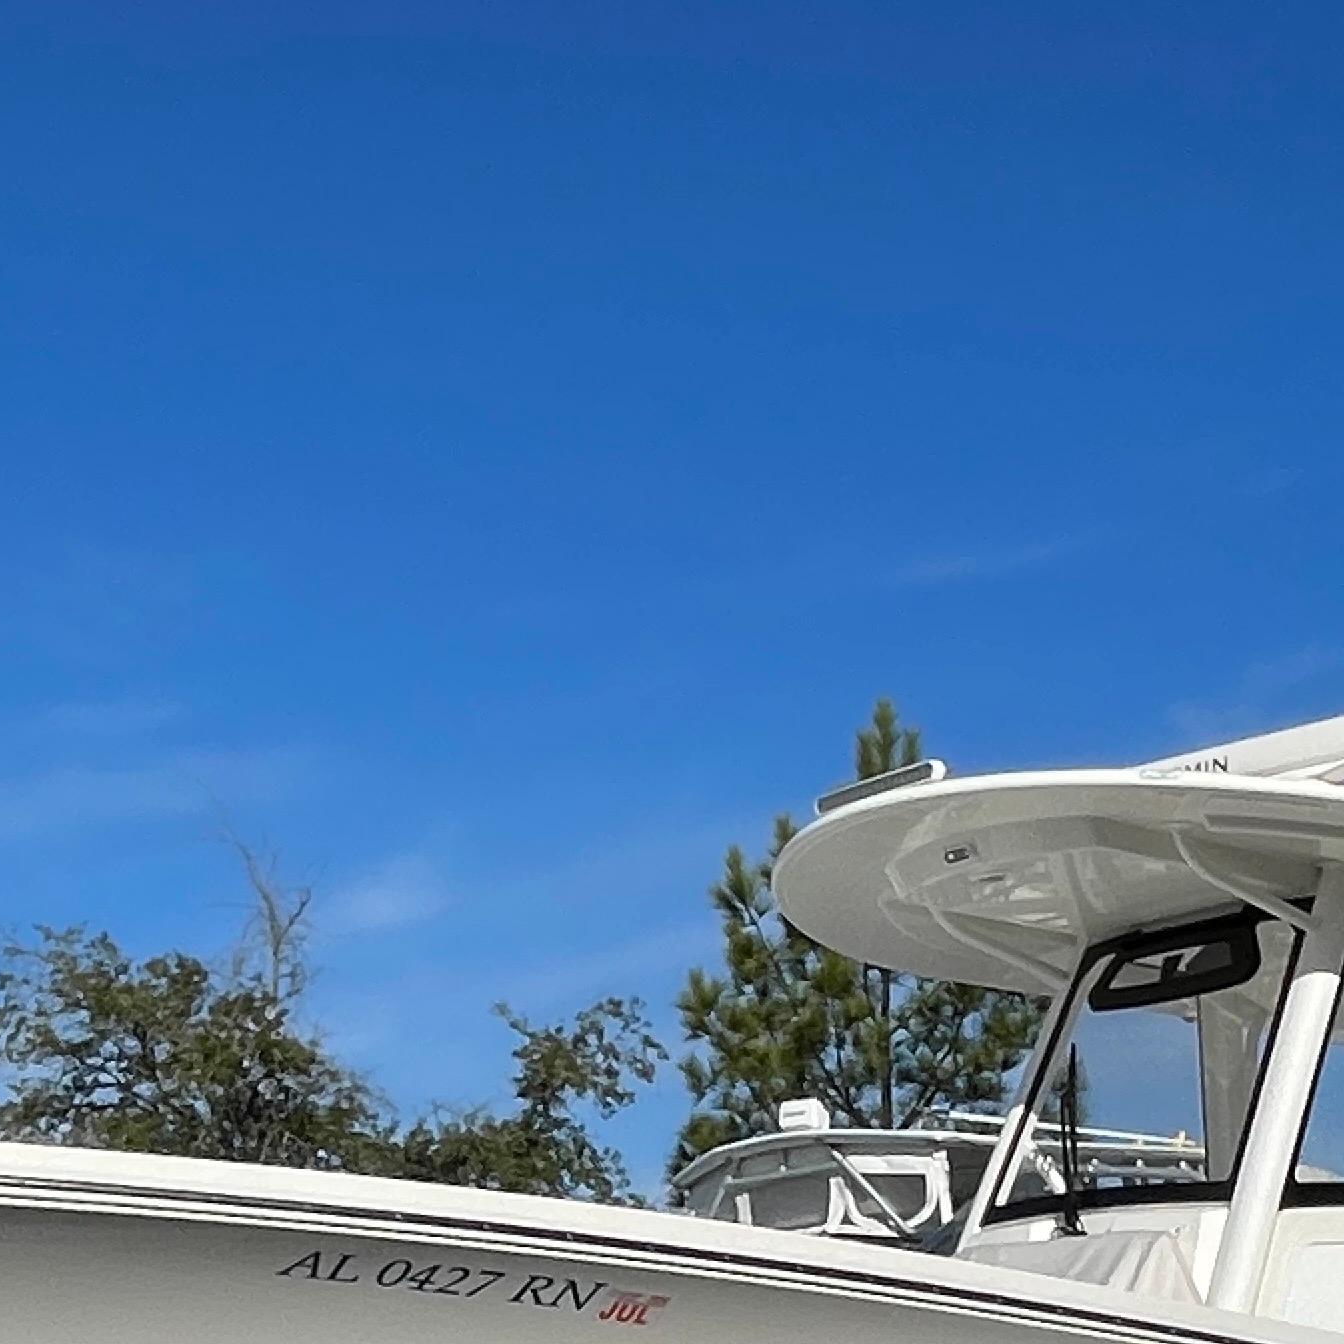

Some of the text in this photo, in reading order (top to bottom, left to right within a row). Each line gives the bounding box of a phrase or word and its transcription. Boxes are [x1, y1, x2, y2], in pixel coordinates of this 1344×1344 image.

[275, 1250, 359, 1282] AL
[376, 1259, 506, 1297] 0427
[508, 1274, 608, 1312] RN
[598, 1300, 651, 1325] JUL
